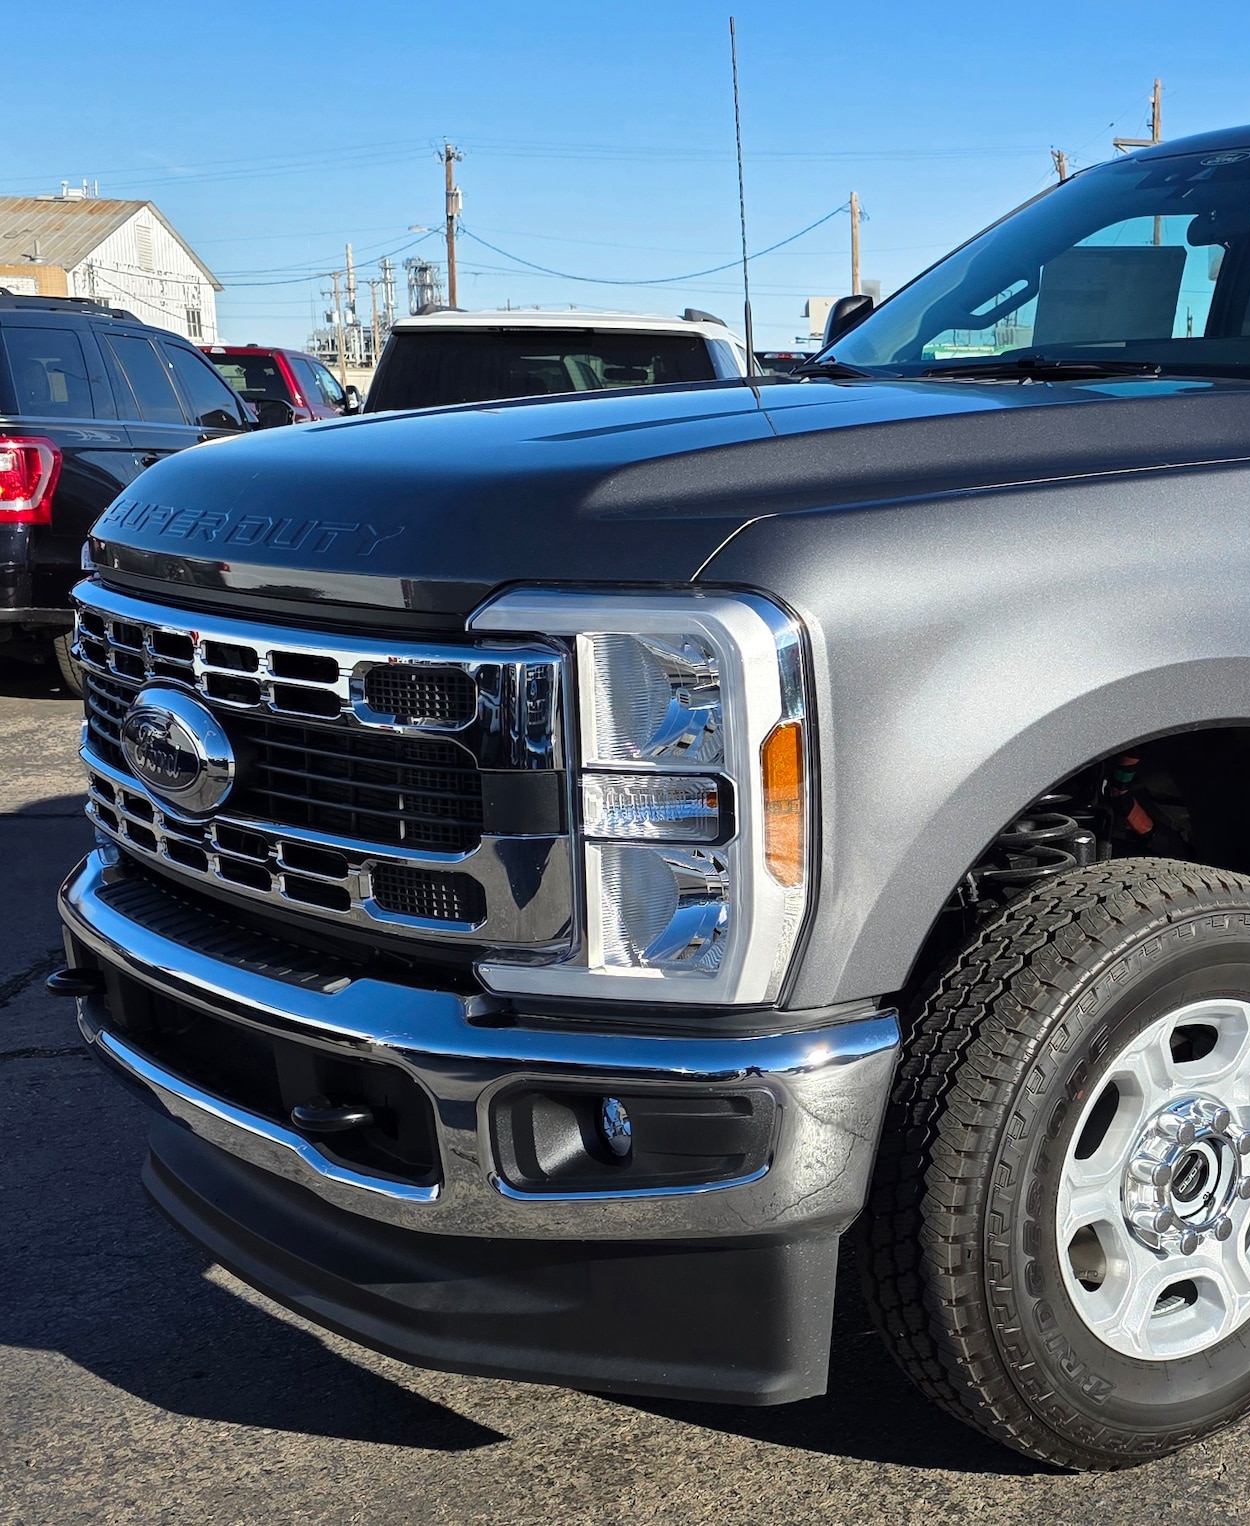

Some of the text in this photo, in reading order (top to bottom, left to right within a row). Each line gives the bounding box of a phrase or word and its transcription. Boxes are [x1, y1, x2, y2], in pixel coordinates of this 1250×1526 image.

[103, 499, 406, 556] SUPER DUTY
[134, 721, 182, 779] Ford
[1022, 1022, 1118, 1403] BRIDGESTONE
